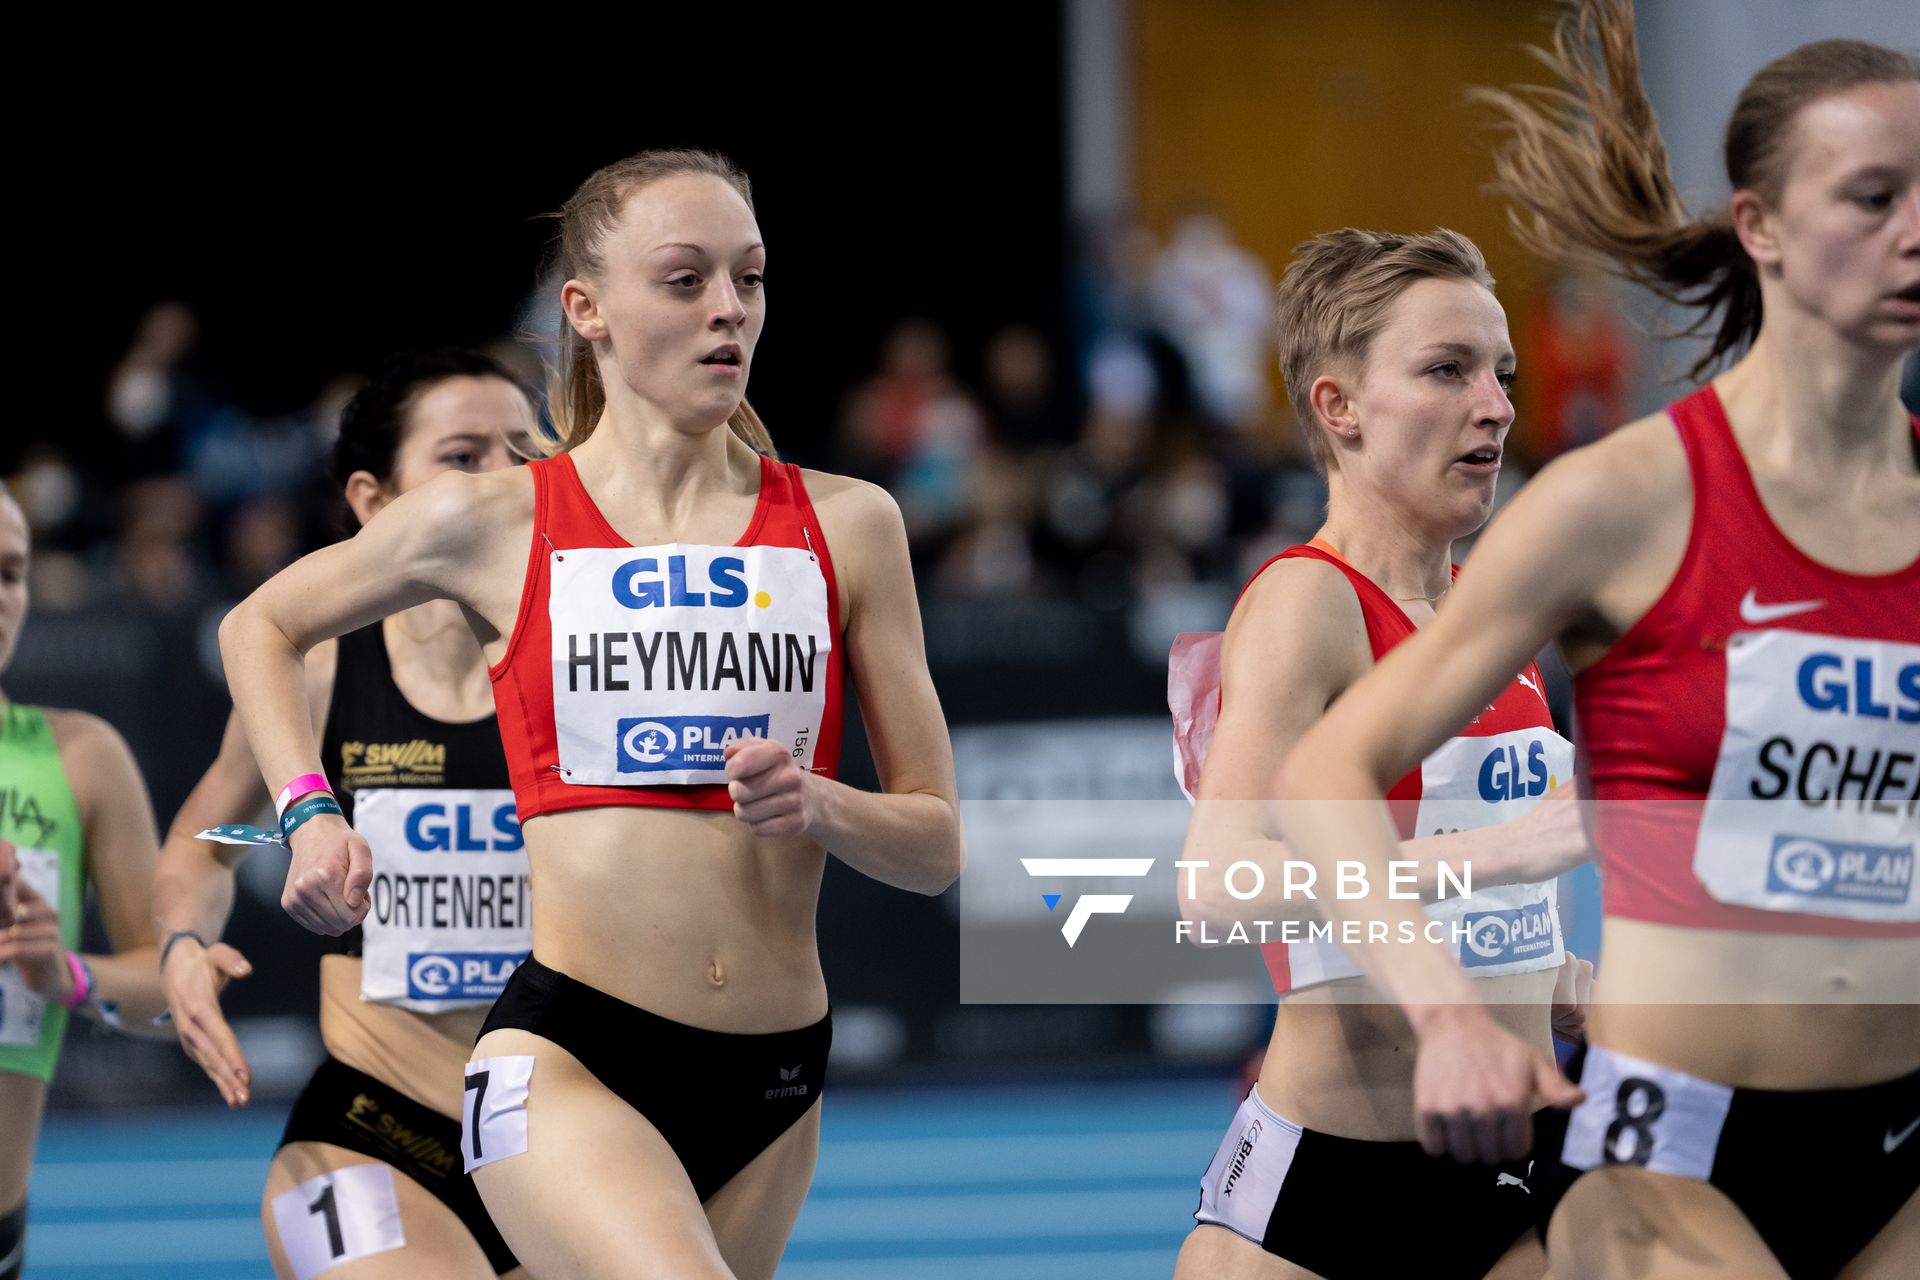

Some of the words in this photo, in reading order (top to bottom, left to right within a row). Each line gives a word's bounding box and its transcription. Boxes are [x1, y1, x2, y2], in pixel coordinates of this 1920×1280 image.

[612, 555, 771, 609] GLS.
[568, 631, 817, 692] HEYMANN
[792, 727, 809, 758] 156
[405, 803, 525, 852] GLS
[1838, 851, 1911, 886] PLAN
[374, 873, 531, 929] ORTENREI
[1511, 911, 1551, 942] PLAN
[463, 959, 524, 983] PLA
[465, 1070, 490, 1160] 7
[765, 1084, 808, 1099] erima
[1604, 1076, 1667, 1167] 8
[1224, 1139, 1253, 1198] Brillux
[308, 1184, 346, 1259] 1
